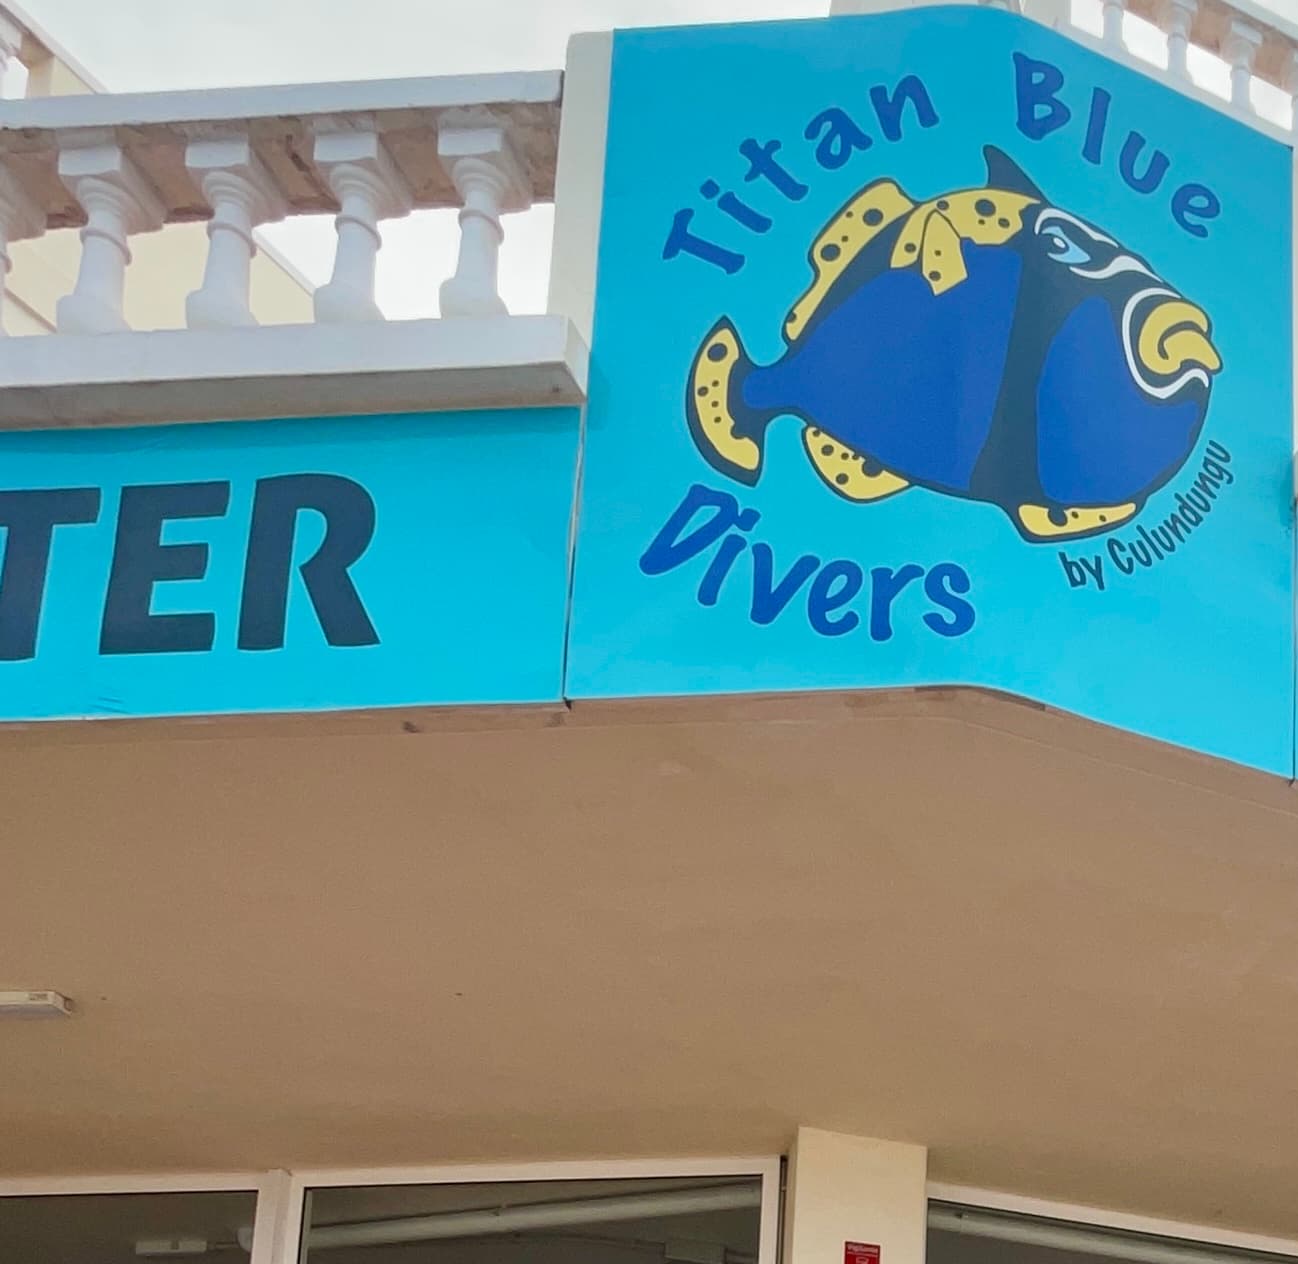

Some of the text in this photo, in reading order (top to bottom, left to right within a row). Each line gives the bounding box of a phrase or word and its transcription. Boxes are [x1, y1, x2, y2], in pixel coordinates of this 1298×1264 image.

[662, 51, 1222, 275] Titan Blue
[639, 484, 976, 642] Divers
[1058, 551, 1105, 591] by
